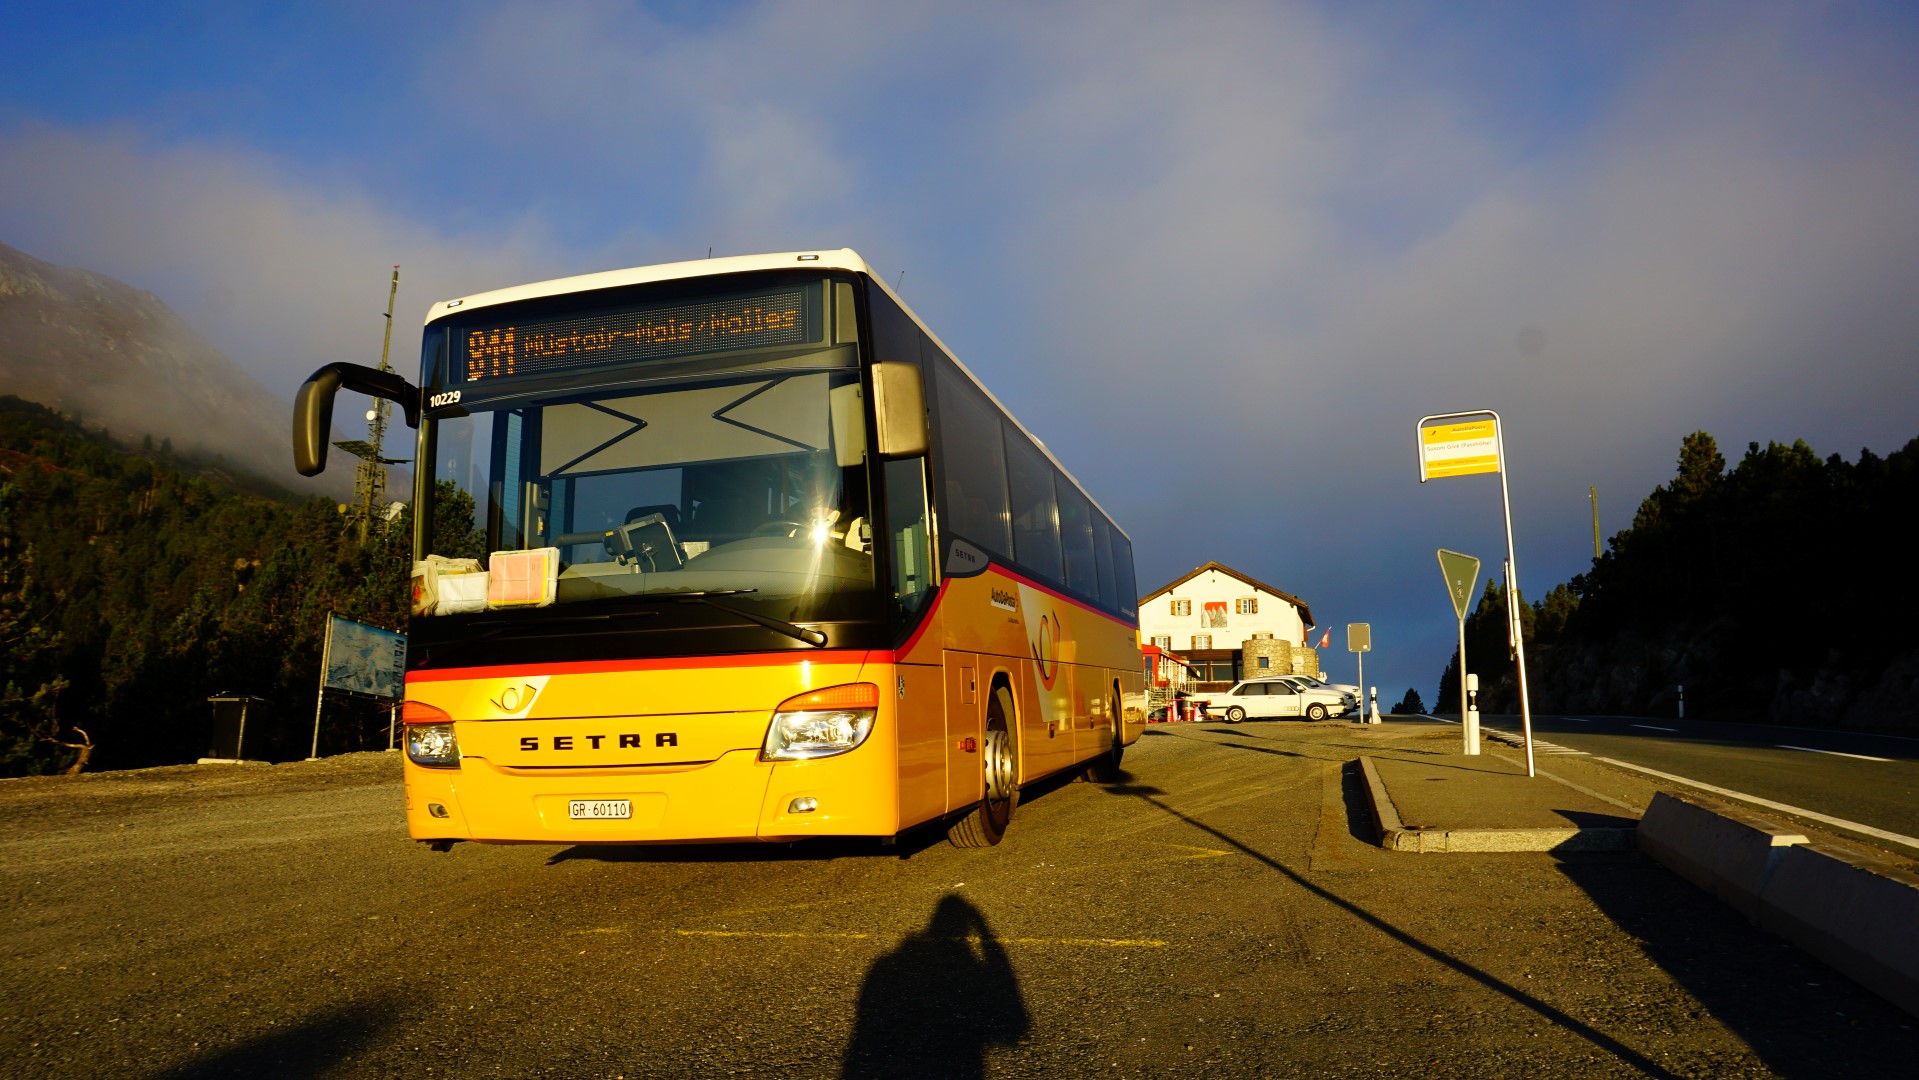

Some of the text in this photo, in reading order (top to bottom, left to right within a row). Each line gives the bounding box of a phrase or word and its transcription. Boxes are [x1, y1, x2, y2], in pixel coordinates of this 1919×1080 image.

[429, 390, 461, 408] 10229
[955, 548, 976, 564] SETRA
[520, 732, 678, 751] SETRA
